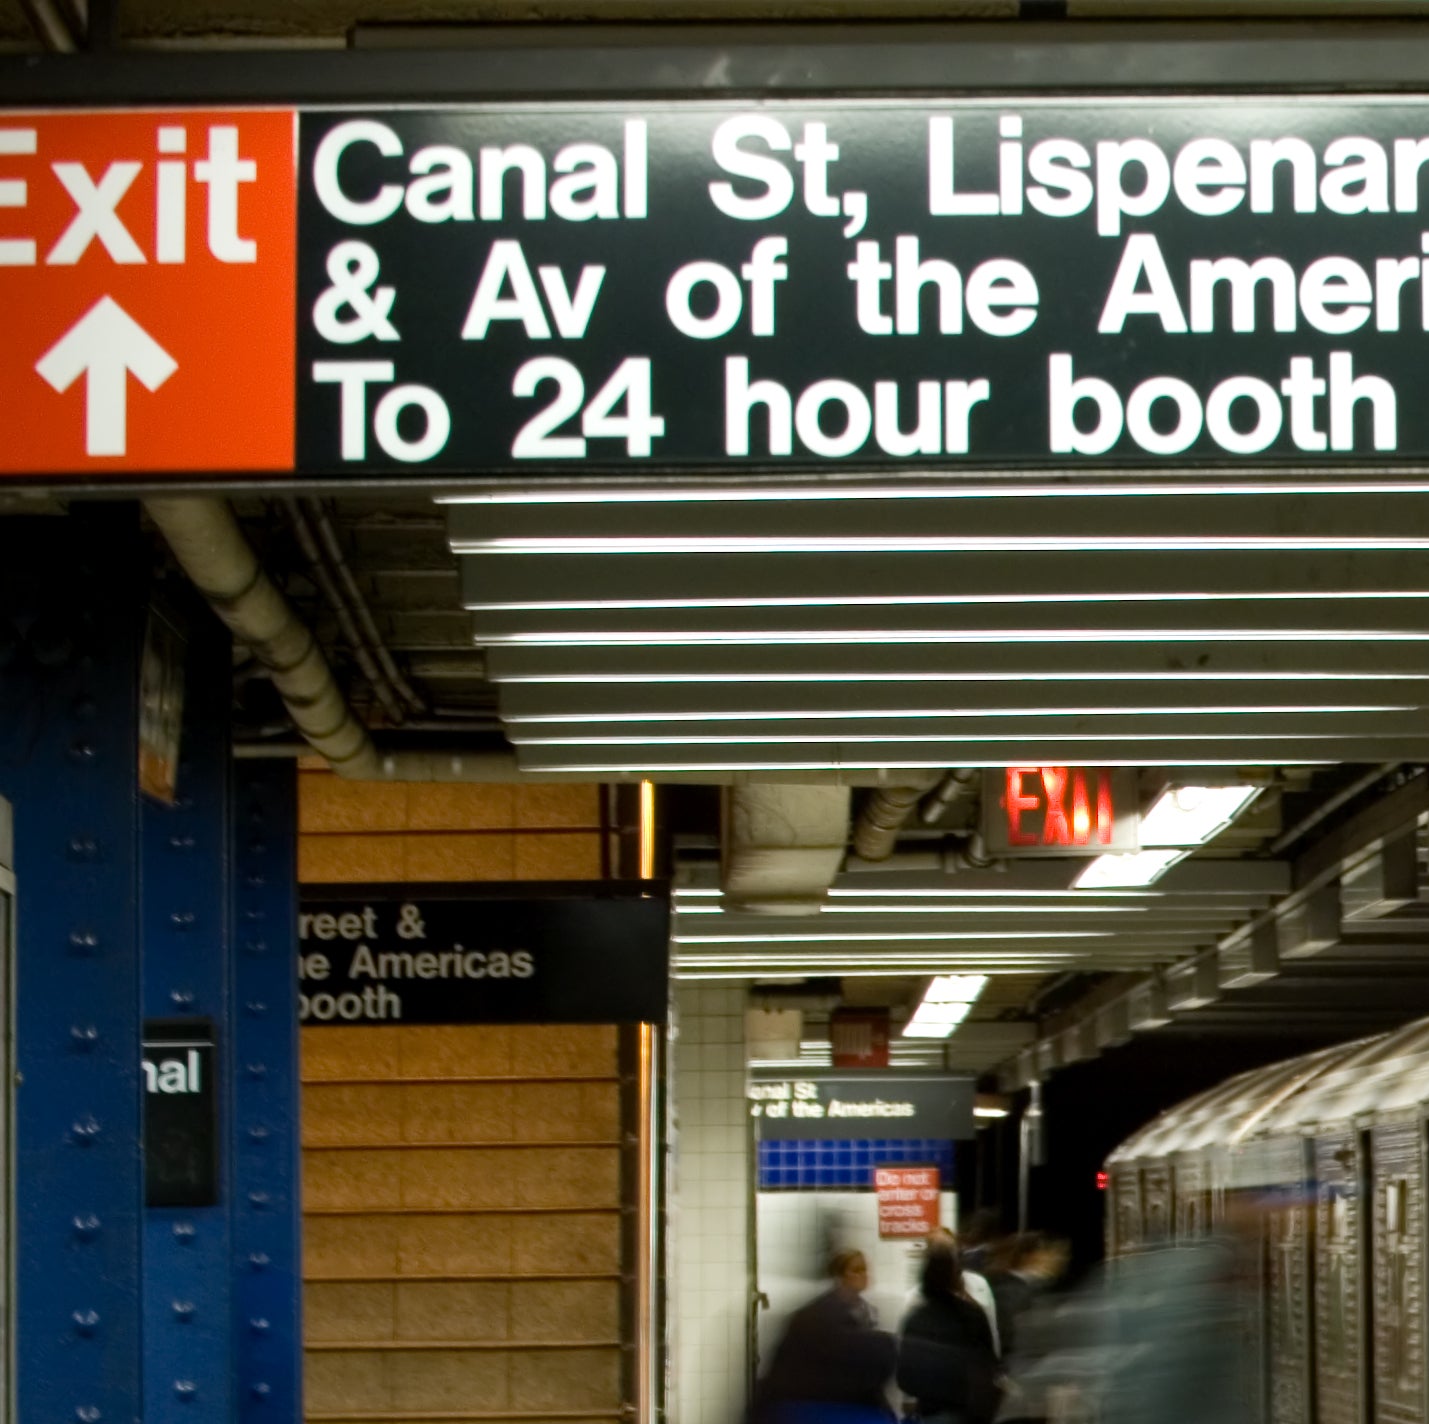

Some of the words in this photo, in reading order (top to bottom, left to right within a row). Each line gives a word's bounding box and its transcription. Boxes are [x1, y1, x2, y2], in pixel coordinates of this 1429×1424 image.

[313, 117, 648, 222] Canal
[708, 112, 867, 238] St,
[312, 240, 400, 342] &
[461, 239, 606, 340] Av
[665, 238, 788, 338] of
[846, 238, 1039, 337] the
[312, 360, 450, 461] To
[511, 356, 665, 458] 24
[725, 357, 990, 457] hour
[1048, 353, 1398, 455] booth
[396, 903, 427, 940] &
[298, 952, 331, 980] e
[349, 942, 536, 980] Americas
[794, 1082, 818, 1100] St
[765, 1100, 788, 1118] of
[791, 1099, 825, 1118] the
[828, 1098, 916, 1118] Americas
[875, 1169, 900, 1187] Do
[902, 1171, 931, 1187] not
[879, 1187, 917, 1201] enter
[919, 1188, 938, 1201] or
[879, 1204, 923, 1217] cross
[880, 1218, 930, 1233] tracks
